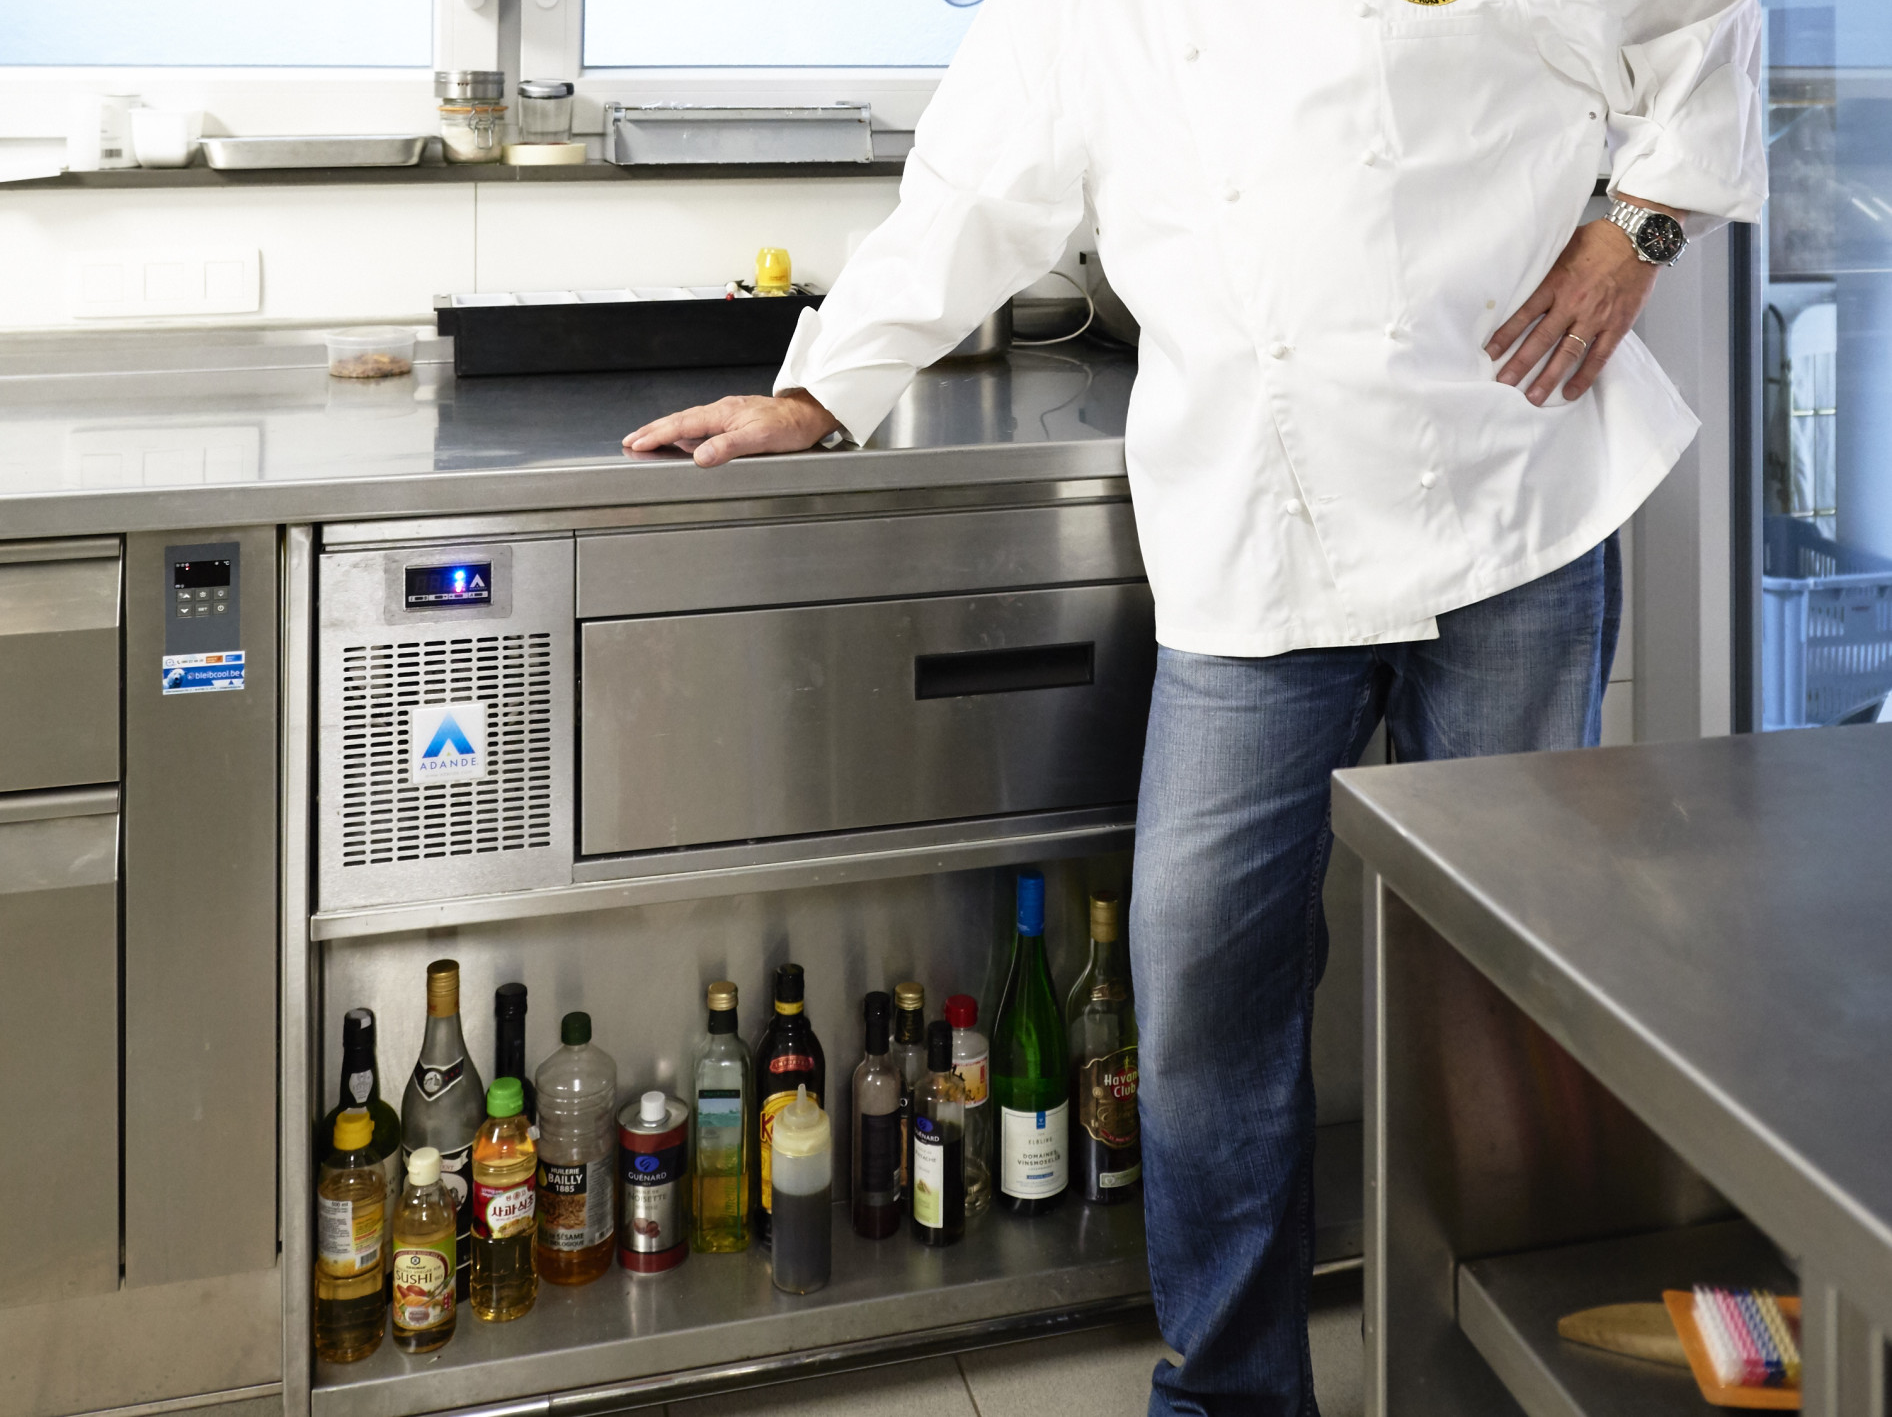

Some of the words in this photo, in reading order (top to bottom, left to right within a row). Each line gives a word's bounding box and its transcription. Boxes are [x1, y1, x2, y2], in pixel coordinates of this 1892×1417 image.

[195, 669, 240, 680] bleibcool.be
[420, 758, 477, 771] ADANDE
[1103, 1071, 1138, 1086] Havan
[1113, 1082, 1137, 1098] Club
[550, 1167, 580, 1175] HUILERIE
[628, 1171, 667, 1182] GUÉNARD
[548, 1173, 583, 1185] BAILLY
[555, 1184, 575, 1193] 1885
[396, 1270, 432, 1285] SUSHI
